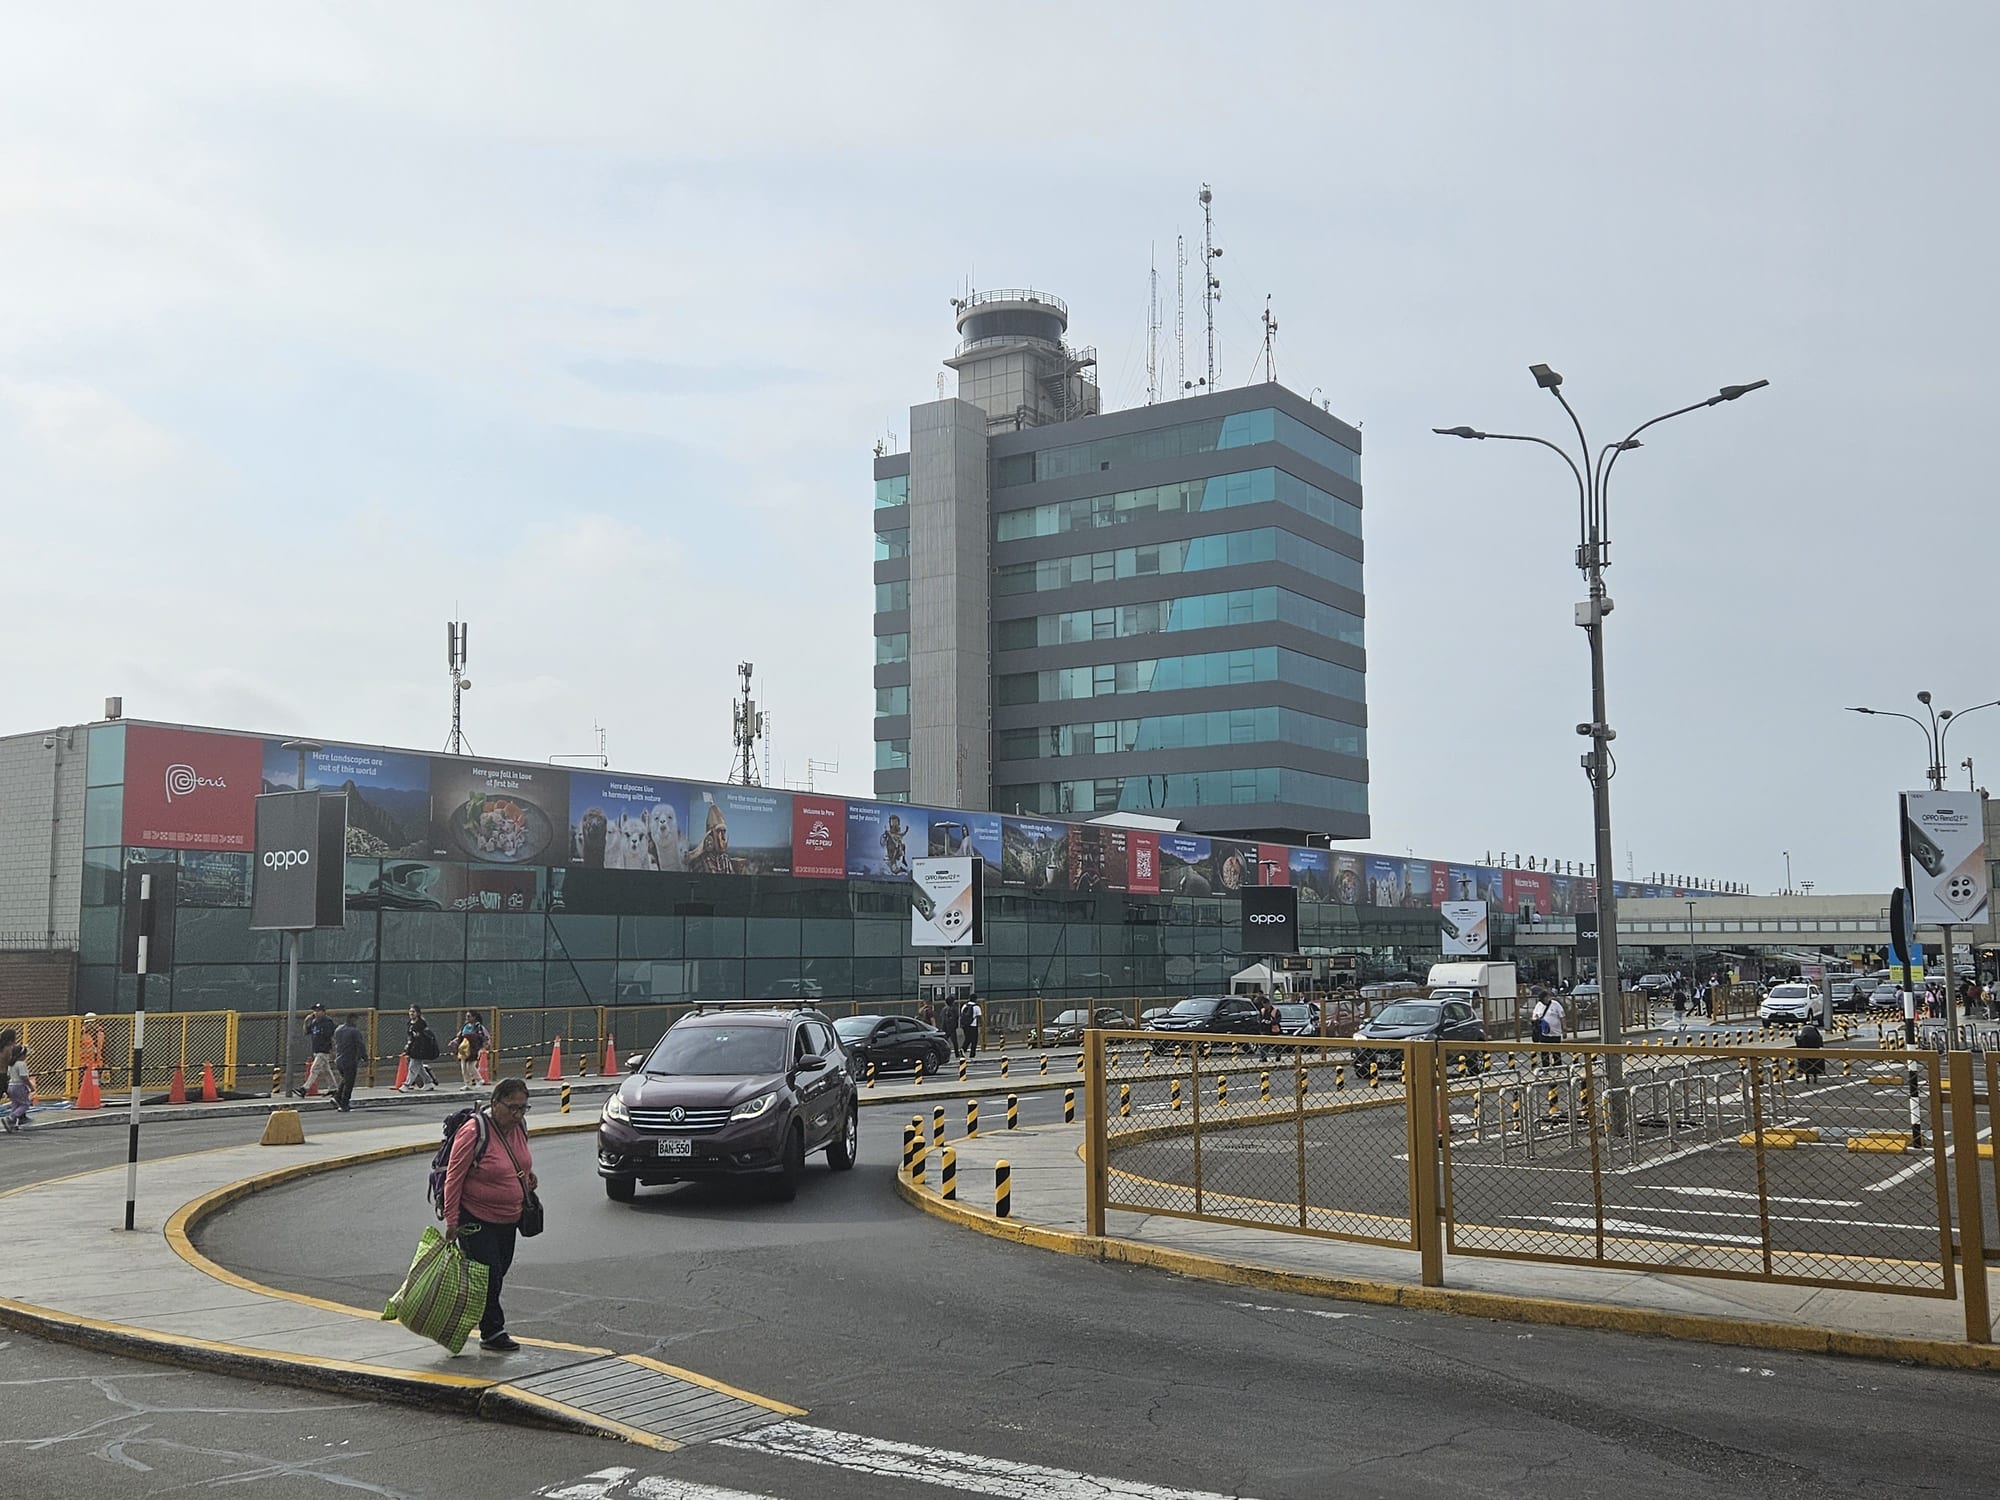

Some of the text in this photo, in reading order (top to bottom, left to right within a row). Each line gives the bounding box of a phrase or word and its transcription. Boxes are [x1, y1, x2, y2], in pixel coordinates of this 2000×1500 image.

[312, 751, 329, 761] Here
[331, 753, 370, 766] landscapes
[318, 764, 377, 776] out of this world
[472, 767, 532, 780] Here you fall in love
[165, 763, 227, 803] Perú
[493, 779, 506, 788] first
[507, 780, 519, 788] bite
[610, 782, 623, 790] Here
[623, 784, 643, 792] alpacas
[608, 791, 631, 802] harmony
[632, 793, 644, 801] with
[263, 849, 309, 871] oppo
[1249, 914, 1286, 925] oppo
[1581, 931, 1599, 939] opp
[659, 1143, 690, 1154] BAN-550
